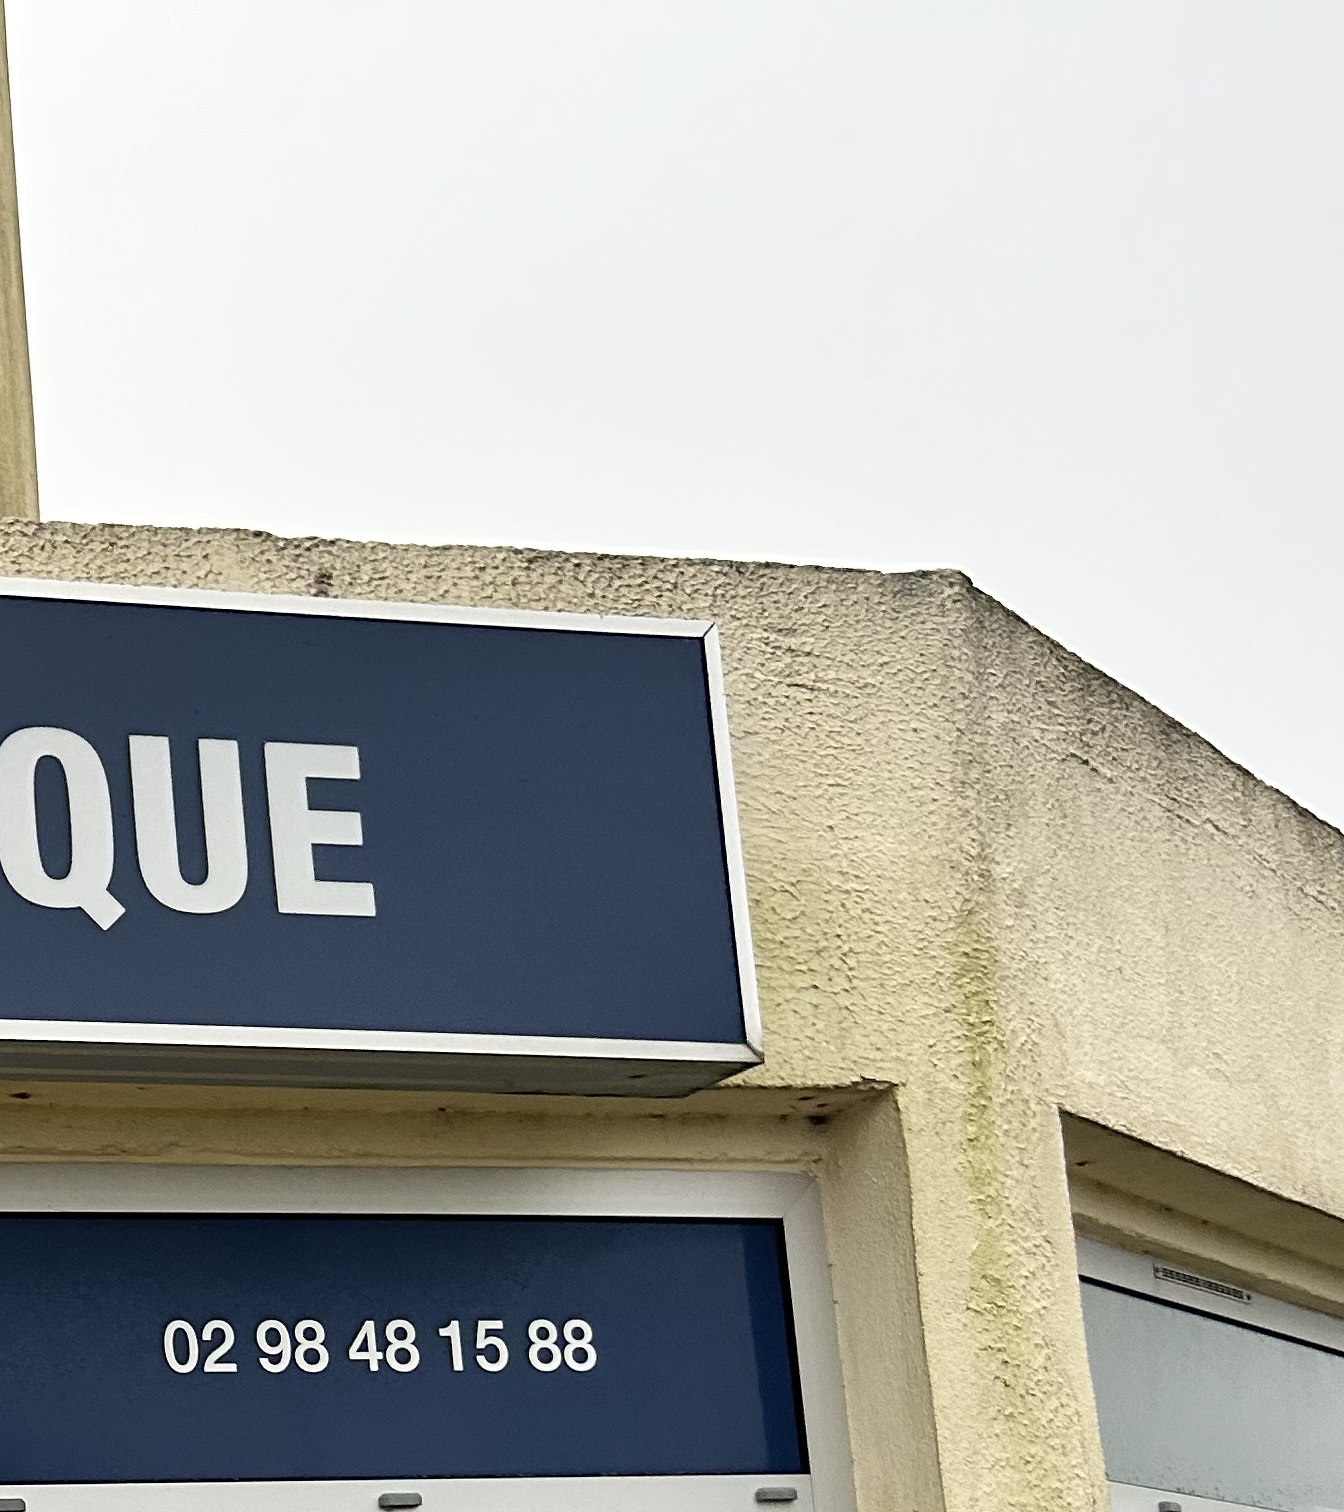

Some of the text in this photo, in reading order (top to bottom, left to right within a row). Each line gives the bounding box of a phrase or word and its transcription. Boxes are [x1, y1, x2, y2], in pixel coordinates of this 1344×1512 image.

[163, 1318, 598, 1374] 02 98 48 15 88
